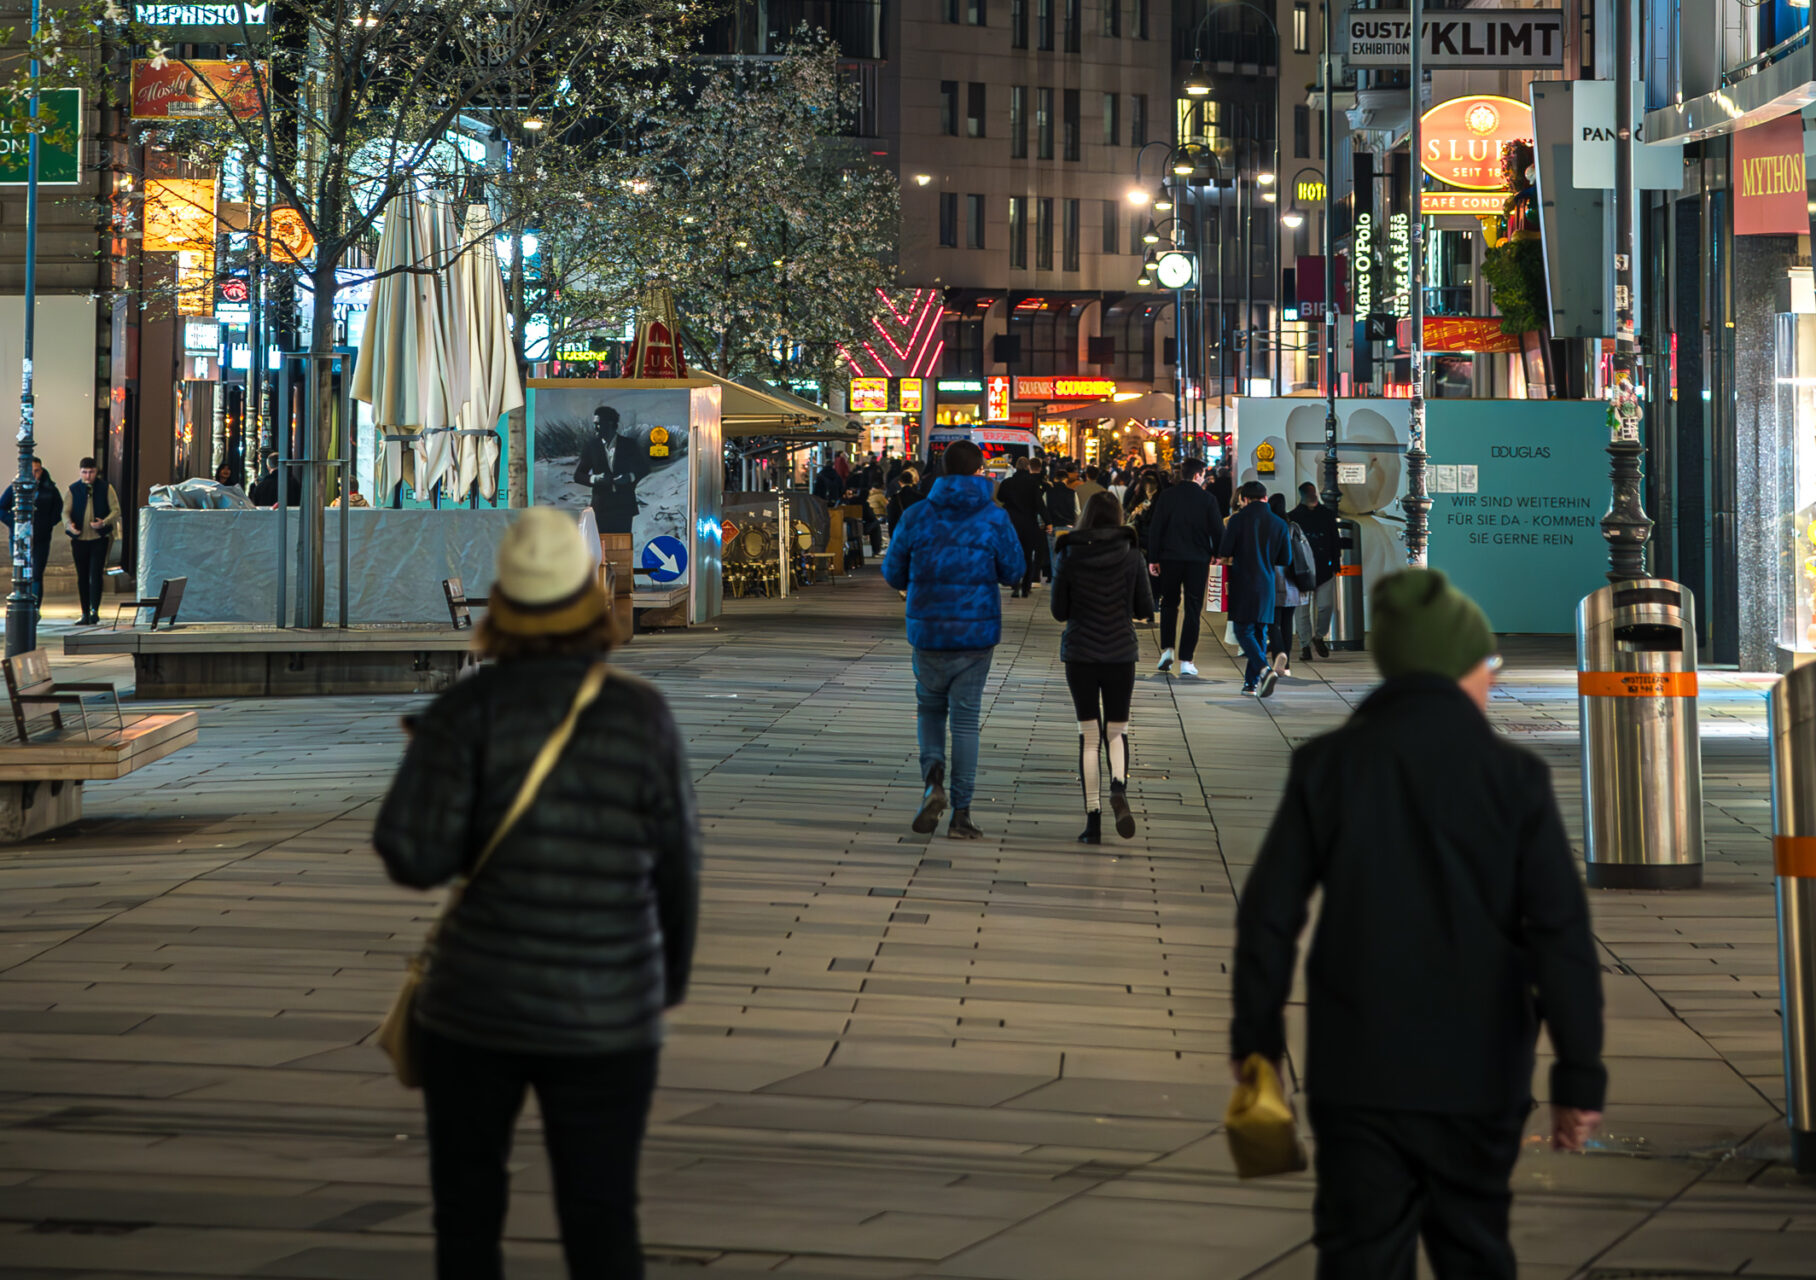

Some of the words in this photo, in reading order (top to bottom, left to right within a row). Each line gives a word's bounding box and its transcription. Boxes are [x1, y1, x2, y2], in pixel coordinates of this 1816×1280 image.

[135, 4, 239, 25] MEPHISTO
[1431, 22, 1560, 56] KLIMT
[1351, 42, 1410, 56] EXHIBITION
[1452, 167, 1482, 178] SEIT
[1742, 153, 1801, 197] MYTHOS
[1421, 196, 1457, 208] CAFÉ
[1355, 212, 1371, 273] O'Polo
[1355, 273, 1371, 323] Marc
[1491, 445, 1551, 459] DOUGLAS
[1452, 496, 1477, 507] WIR
[1481, 496, 1513, 508] SIND
[1516, 497, 1591, 509] WEITERHIN
[1448, 512, 1473, 526] FÜR
[1477, 515, 1497, 526] SIE
[1501, 515, 1520, 526] DA
[1532, 516, 1596, 528] KOMMEN
[1469, 532, 1489, 544] SIE
[1493, 533, 1541, 545] GERNE
[1543, 534, 1574, 545] REIN
